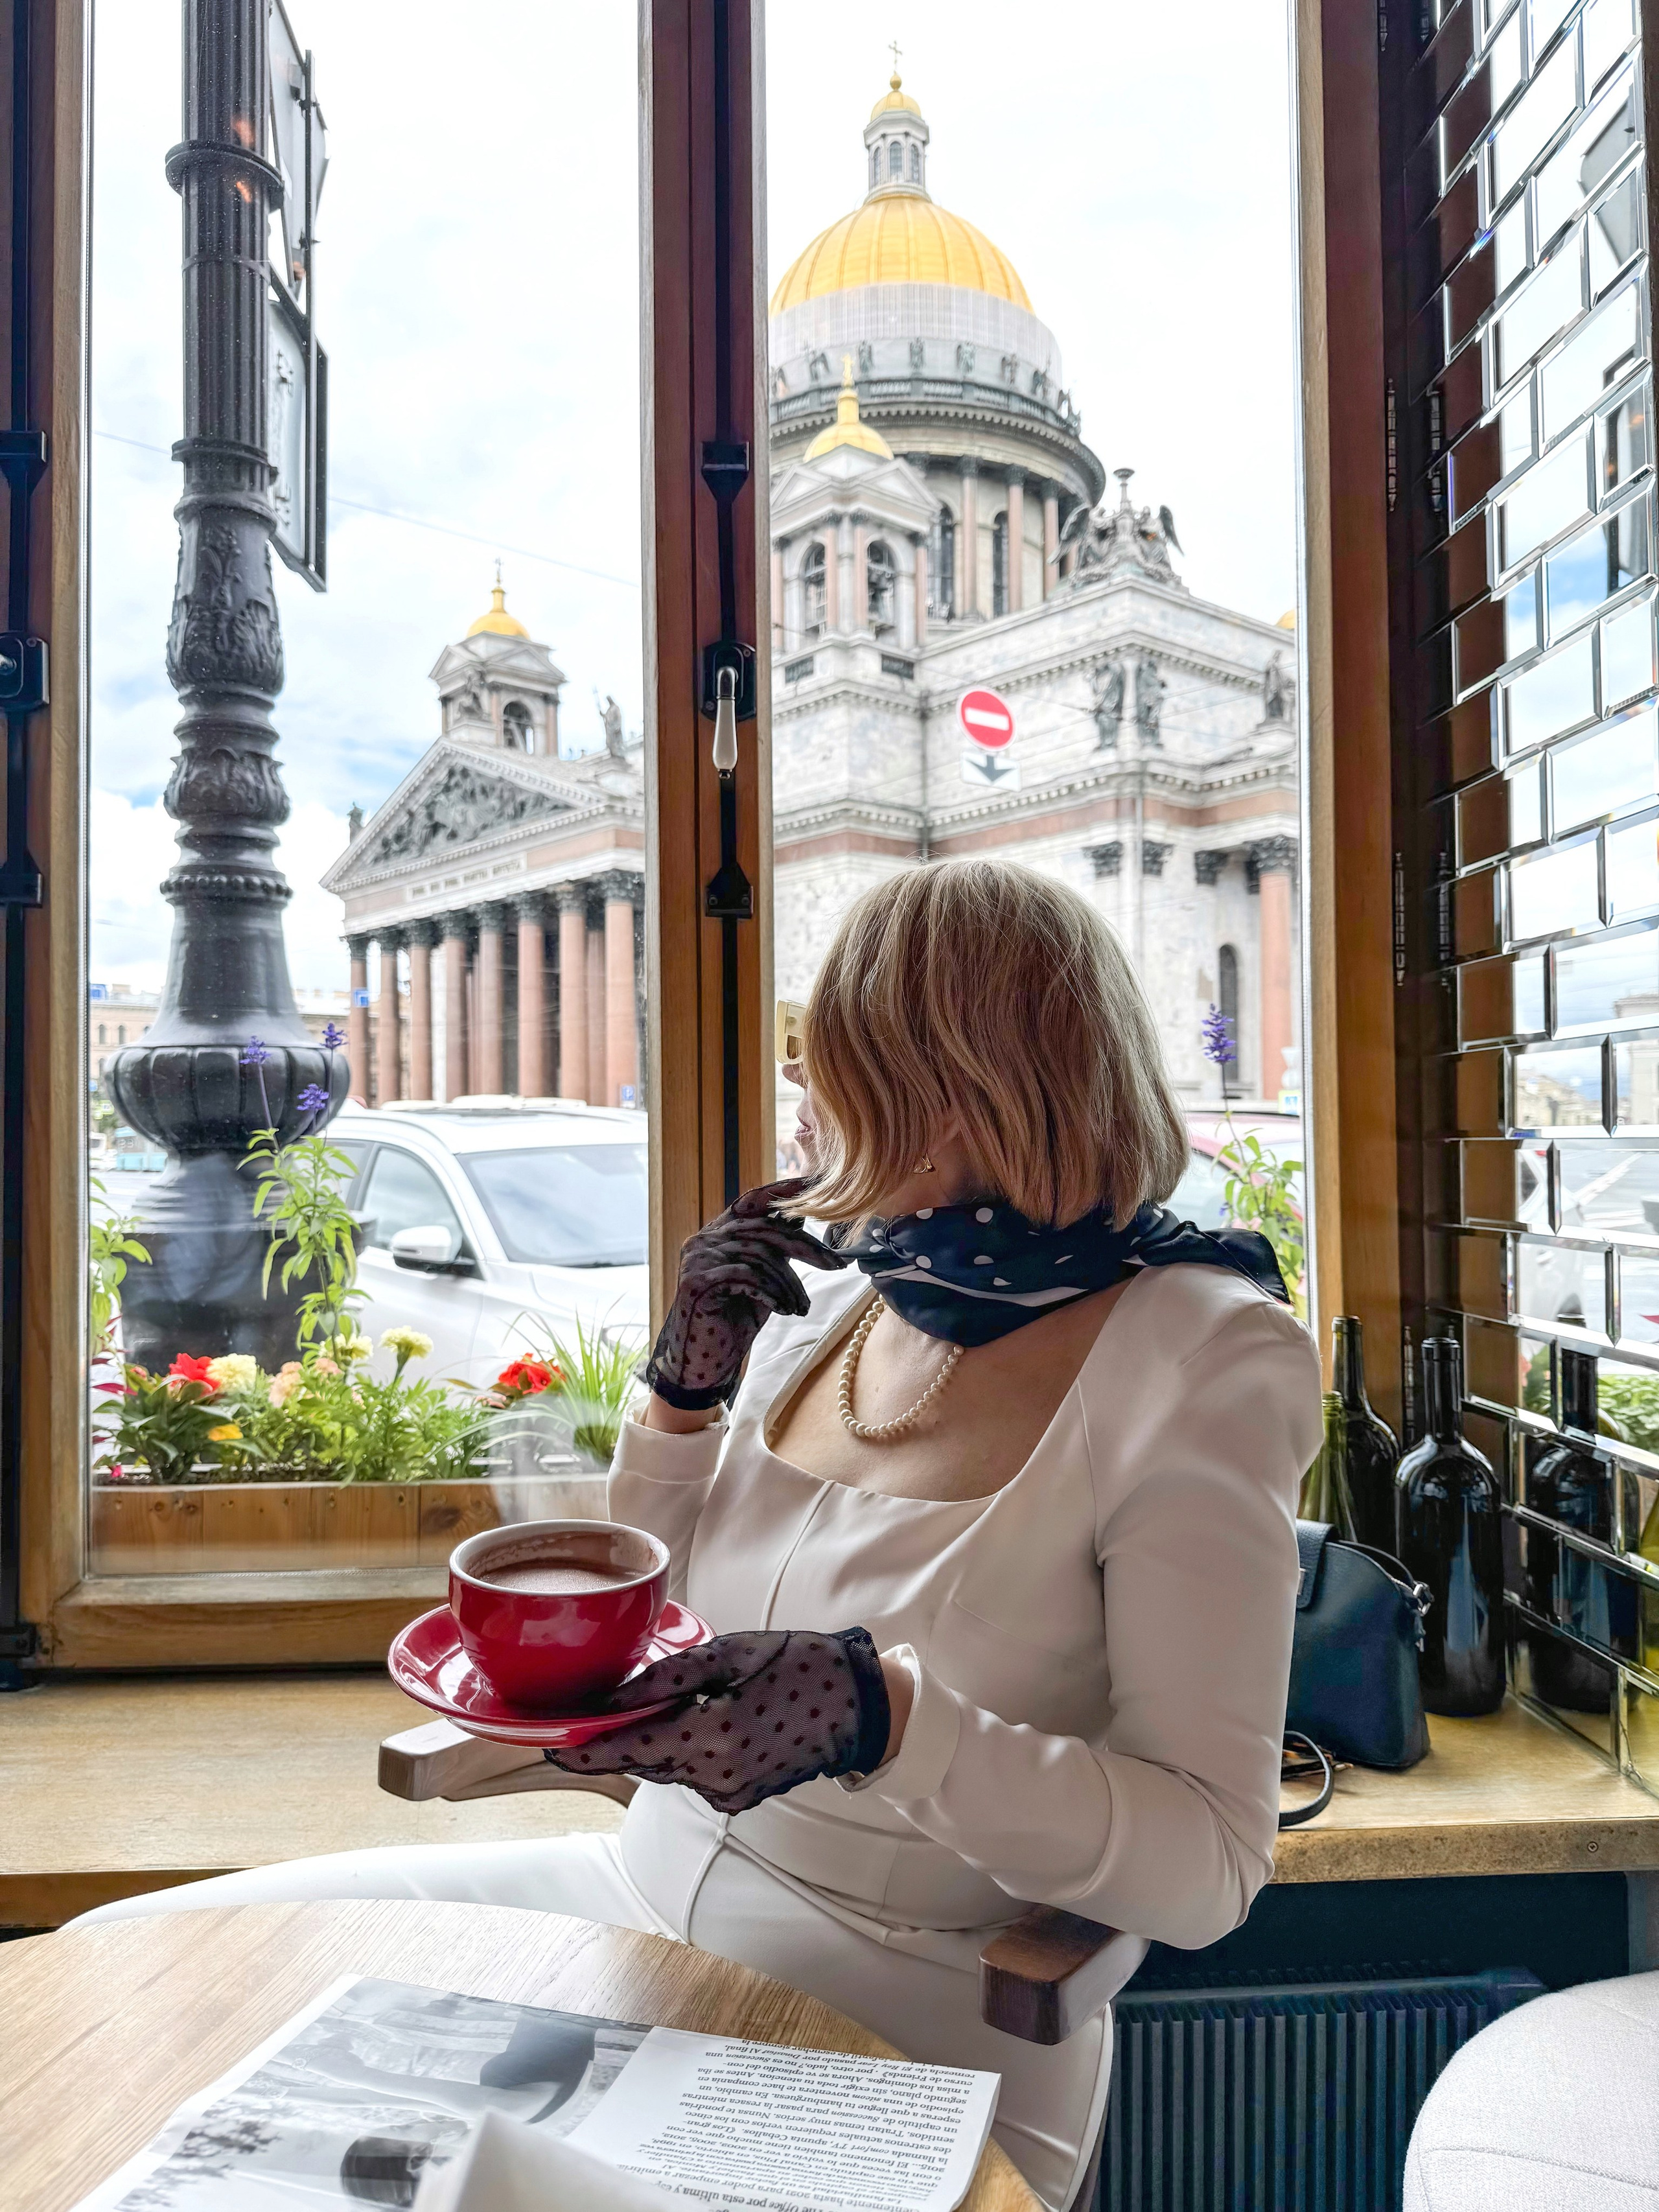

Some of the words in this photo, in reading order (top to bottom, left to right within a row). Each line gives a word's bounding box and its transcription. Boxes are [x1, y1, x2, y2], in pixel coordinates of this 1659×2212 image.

[726, 2054, 771, 2063] Succession
[763, 2066, 804, 2075] episodio
[857, 2062, 879, 2070] Lear
[726, 2070, 755, 2080] Antes
[758, 2073, 802, 2082] atencion.
[831, 2074, 864, 2082] Ahora
[930, 2069, 975, 2078] remezcla
[712, 2077, 760, 2086] compania
[866, 2078, 918, 2090] domingos.
[715, 2086, 753, 2095] cambio,
[761, 2083, 785, 2091] hace
[799, 2087, 850, 2097] noventera
[682, 2093, 728, 2102] mientras
[852, 2094, 881, 2102] sitcom
[890, 2090, 922, 2100] plano,
[923, 2094, 967, 2104] segundo
[772, 2093, 843, 2108] hamburguesa.
[680, 2102, 725, 2112] pondrias
[858, 2104, 889, 2115] llegue
[920, 2104, 964, 2114] episodio
[685, 2112, 713, 2120] cinco
[738, 2109, 771, 2119] Nunsa
[774, 2113, 806, 2122] serios.
[831, 2111, 880, 2123] Succession
[920, 2113, 960, 2123] esperas
[807, 2117, 831, 2125] muy
[833, 2121, 865, 2130] temas
[898, 2120, 941, 2130] capitulo
[742, 2128, 788, 2141] Ceballos.
[785, 2125, 837, 2136] requieren
[868, 2126, 904, 2137] Tratan
[726, 2136, 763, 2145] mucho
[791, 2136, 828, 2145] apunta
[839, 2132, 883, 2143] actuales
[907, 2132, 955, 2143] sentidos.
[830, 2141, 848, 2150] TV,
[851, 2145, 889, 2154] comfort
[885, 2139, 931, 2150] estrenos
[693, 2145, 735, 2155] abierto,
[794, 2146, 838, 2157] tambien
[933, 2146, 951, 2155] des
[753, 2154, 778, 2163] Plus,
[793, 2154, 824, 2163] volvio
[840, 2153, 895, 2167] fenomeno
[892, 2150, 936, 2163] llamada
[780, 2160, 812, 2168] Canal
[672, 2172, 720, 2183] empezar
[673, 2185, 682, 2193] y
[721, 2180, 756, 2190] poder
[758, 2184, 784, 2194] para
[683, 2187, 719, 2202] ultima
[785, 2189, 811, 2198] 2021
[723, 2194, 745, 2204] esta
[746, 2198, 768, 2207] por
[813, 2194, 844, 2207] hasta
